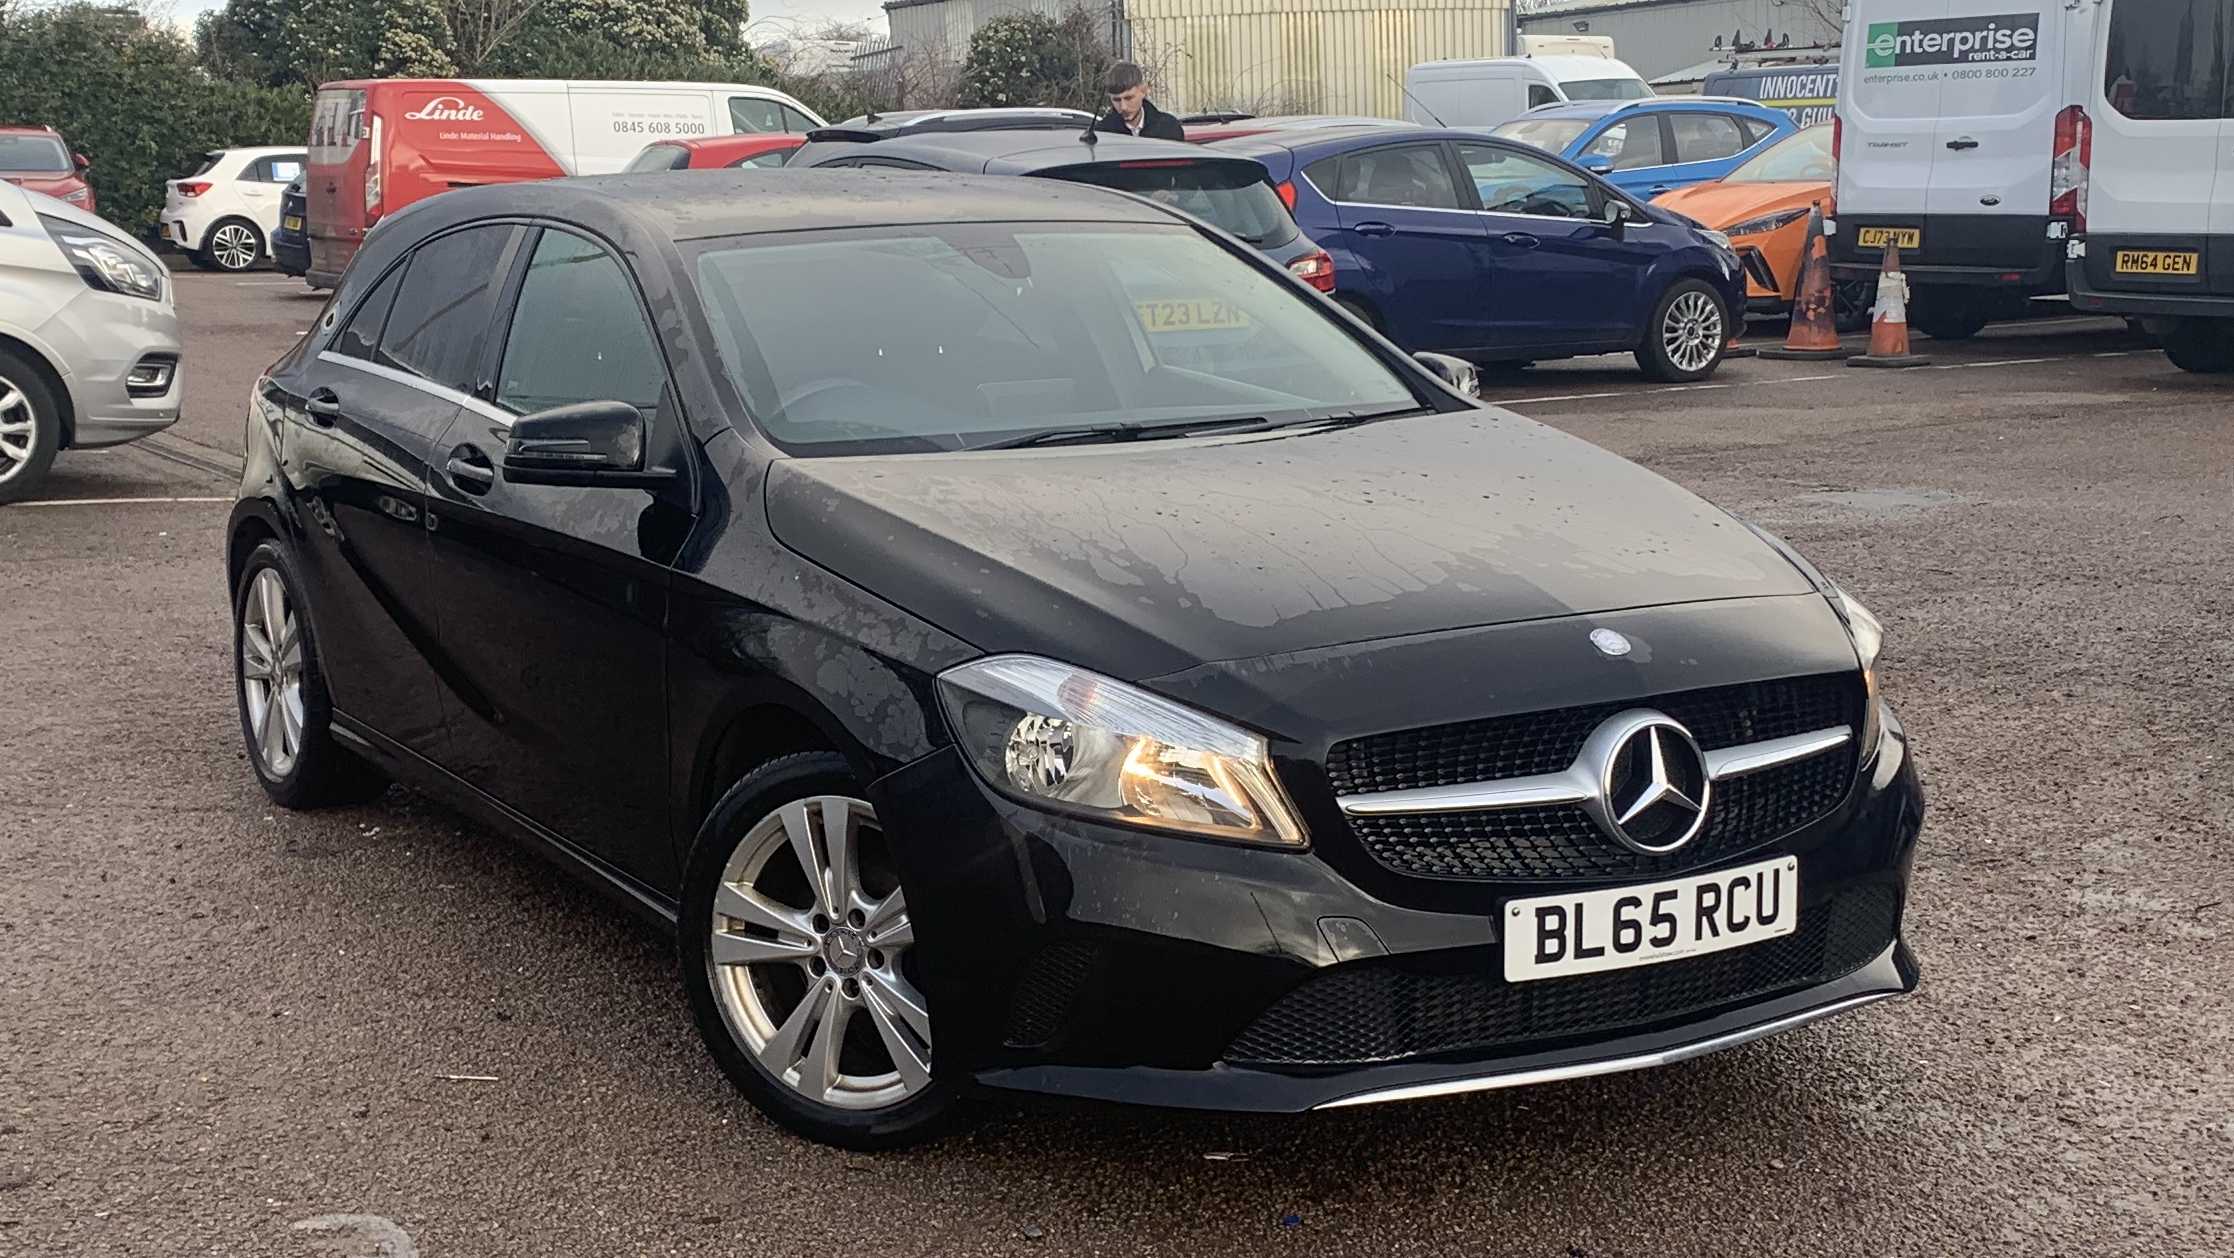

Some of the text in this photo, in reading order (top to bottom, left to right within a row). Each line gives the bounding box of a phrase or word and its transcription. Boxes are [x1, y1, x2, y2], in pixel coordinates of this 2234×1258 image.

[1867, 22, 2035, 59] enterprise
[1968, 49, 2034, 61] rent-a-car
[1863, 66, 2036, 85] enterprise.co.uk 0800 800 227
[1760, 73, 1840, 99] INNOCENT
[404, 96, 485, 120] Linde
[613, 120, 705, 134] 0845 608 5000
[439, 131, 522, 143] Linde Material Handling
[2120, 253, 2192, 272] RM64 GEN
[1534, 867, 1781, 965] BL65 RCU
